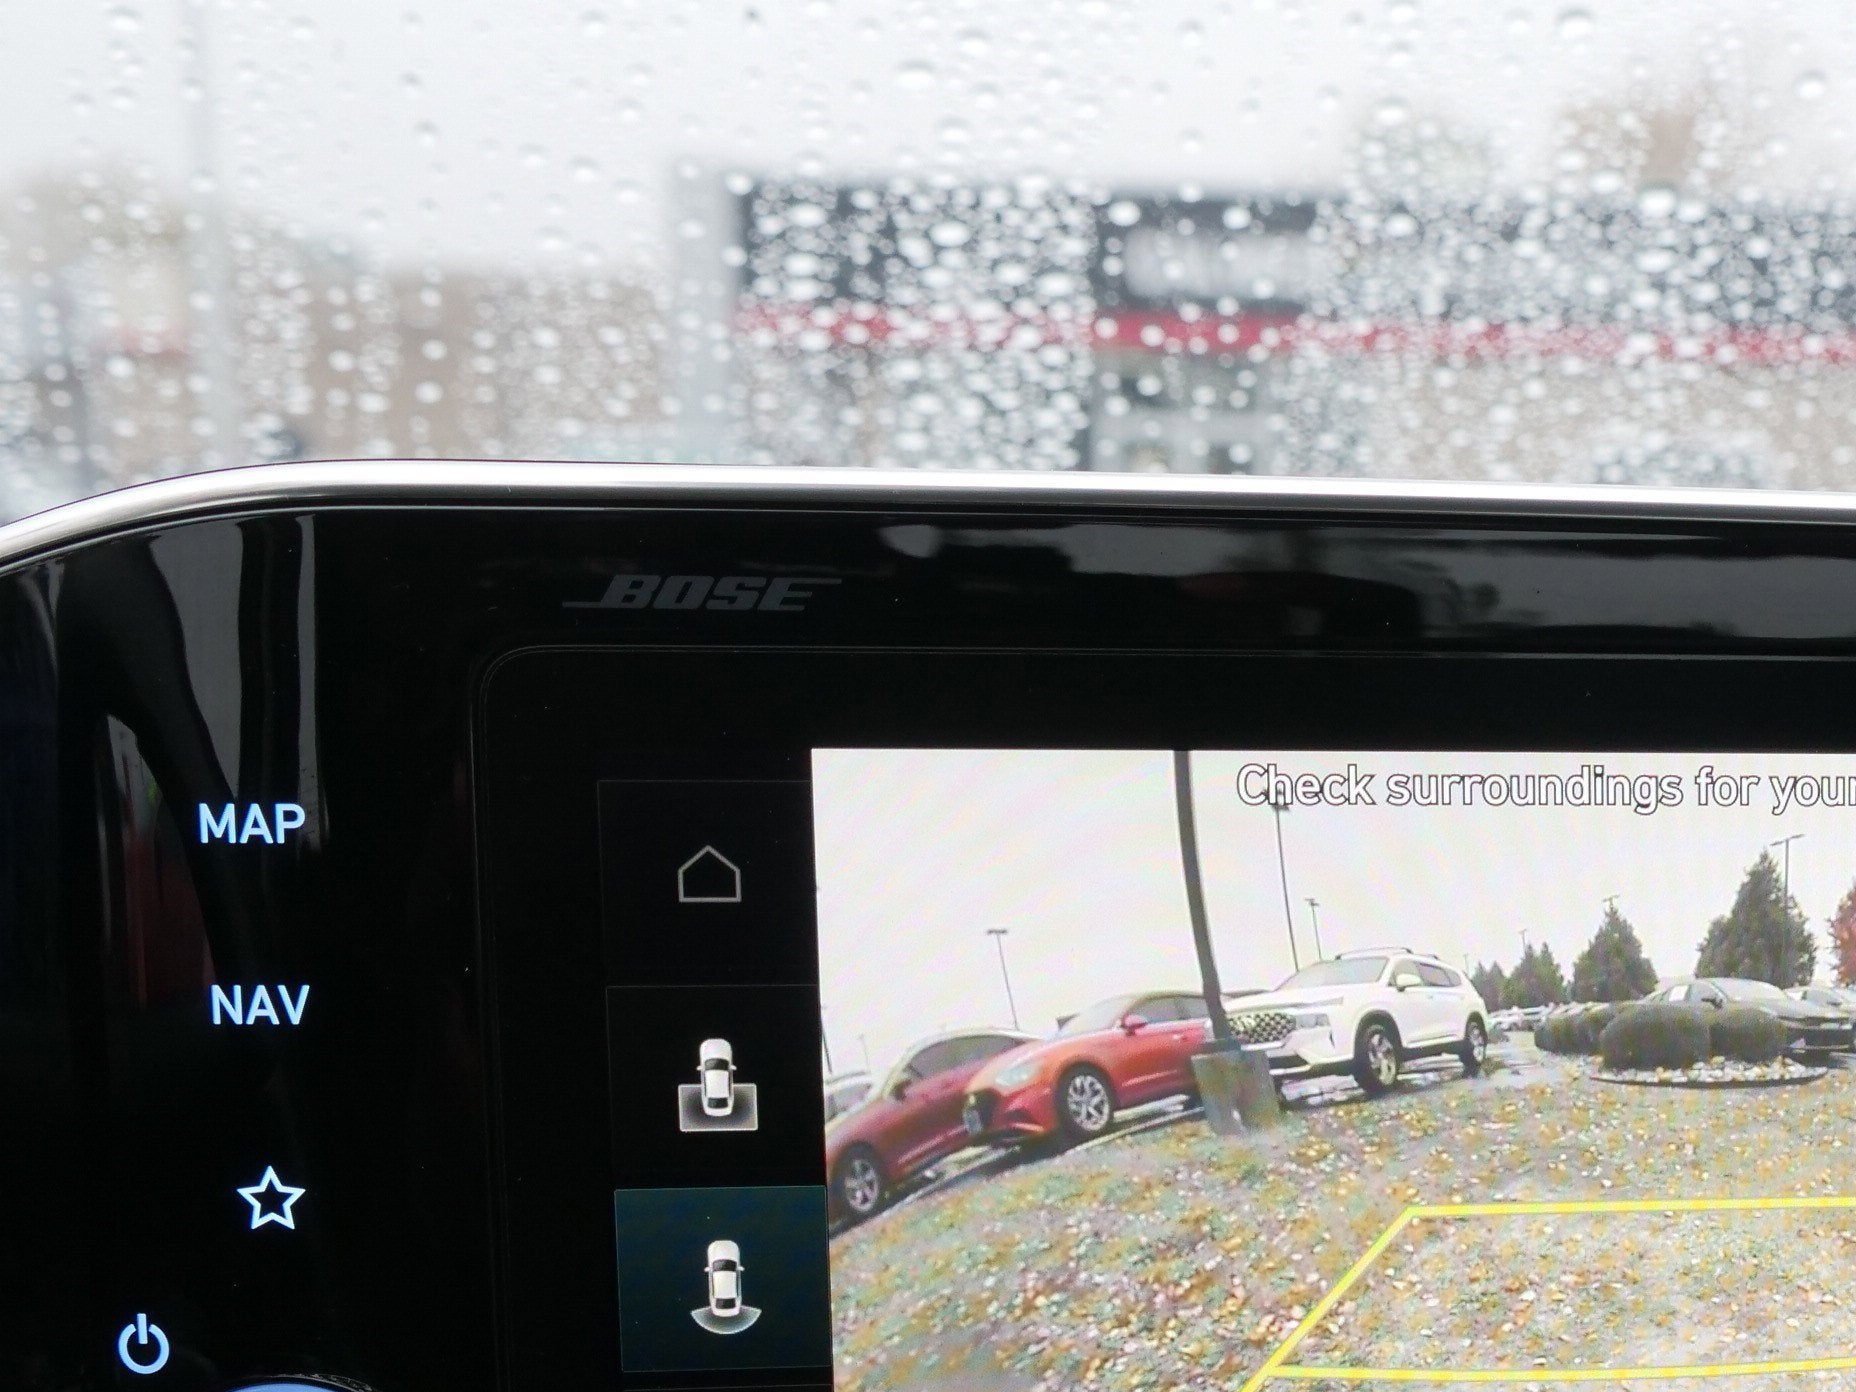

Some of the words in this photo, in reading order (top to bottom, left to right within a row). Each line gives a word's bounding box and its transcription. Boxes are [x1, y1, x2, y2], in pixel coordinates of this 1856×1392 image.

[562, 574, 843, 612] BOSE
[1237, 763, 1377, 806] Check
[1386, 764, 1685, 816] surroundings
[1694, 765, 1761, 807] for
[198, 802, 307, 846] MAP
[210, 984, 311, 1027] NAV
